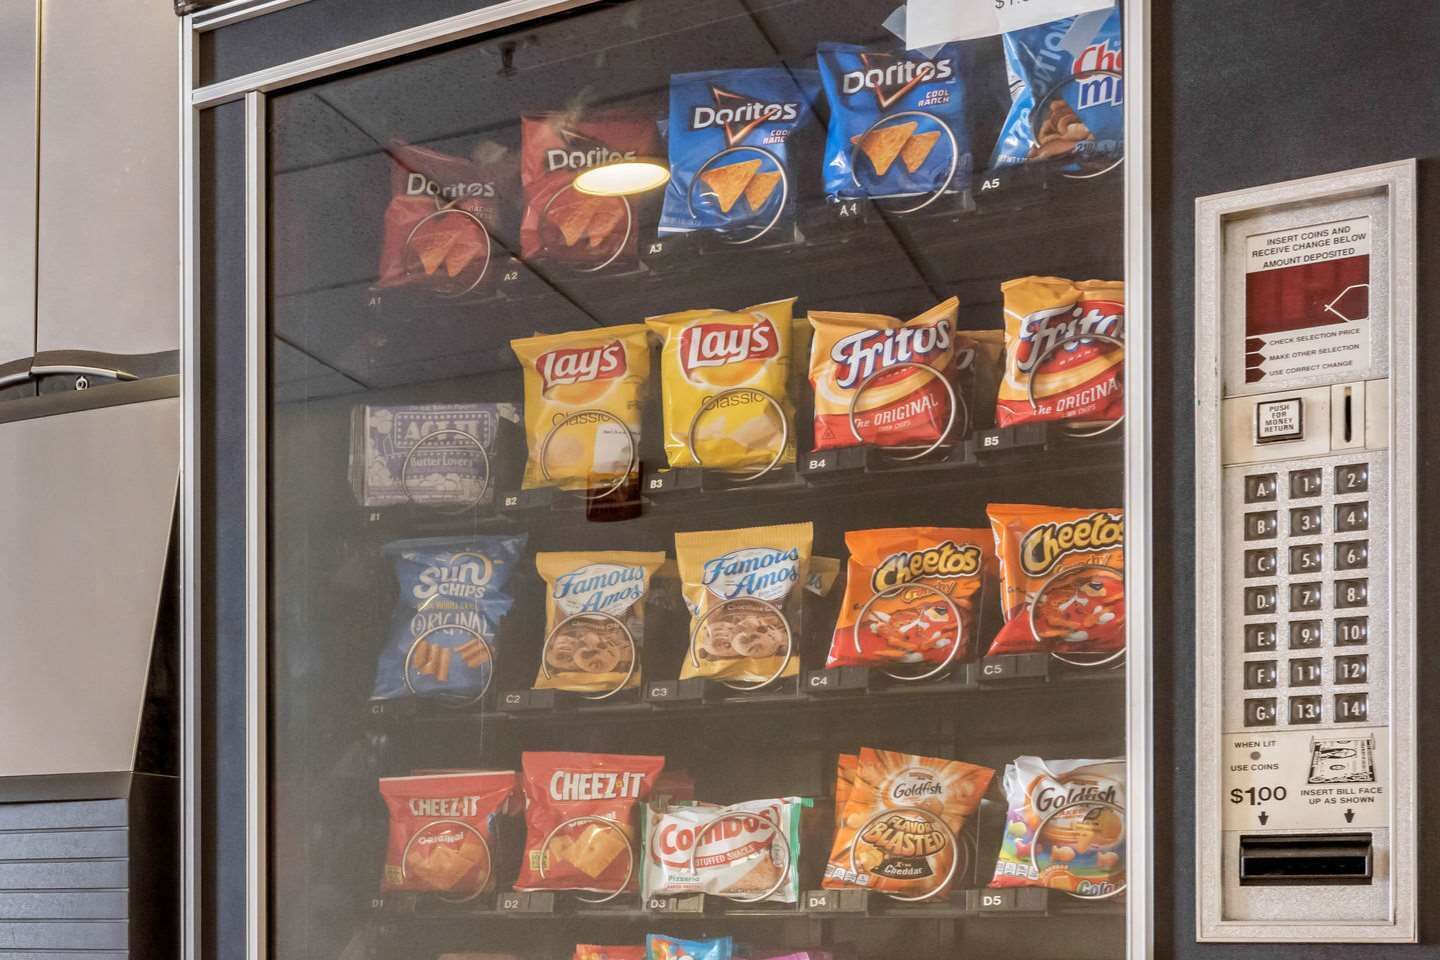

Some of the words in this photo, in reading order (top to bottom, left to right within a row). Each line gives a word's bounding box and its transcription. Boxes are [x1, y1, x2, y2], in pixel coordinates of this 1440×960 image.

[843, 58, 952, 94] Doritos
[694, 101, 799, 129] Doritos
[547, 147, 638, 171] Doritos
[407, 173, 496, 198] Doritos
[981, 178, 1000, 191] A5
[840, 203, 857, 216] A4
[1267, 234, 1298, 245] INSERT
[1301, 229, 1329, 240] COINS
[1332, 226, 1351, 235] AND
[649, 244, 664, 255] A3
[1252, 246, 1290, 258] RECEIVE
[1293, 239, 1331, 252] CHANGE
[1333, 233, 1367, 244] BELOW
[1263, 256, 1302, 269] AMOUNT
[1304, 247, 1355, 263] DEPOSITED
[504, 271, 520, 281] A2
[1017, 303, 1124, 373] Frito
[1269, 337, 1294, 346] CHECK
[1296, 331, 1337, 343] SELECTION
[1339, 328, 1361, 338] PRICE
[687, 323, 771, 371] Lay's
[831, 319, 950, 388] Fritos
[1269, 352, 1290, 361] MAKE
[1292, 349, 1316, 358] OTHER
[1318, 344, 1360, 355] SELECTION
[542, 343, 621, 386] Lay's
[1269, 368, 1284, 376] USE
[1285, 363, 1320, 375] CORRECT
[1322, 360, 1353, 370] CHANGE
[1056, 377, 1119, 411] ORIGINA
[874, 393, 939, 425] ORIGINAL
[1269, 404, 1290, 412] PUSH
[1271, 411, 1287, 419] FOR
[1264, 424, 1294, 432] RETURN
[1265, 418, 1293, 426] MONEY
[984, 436, 999, 447] B5
[810, 459, 826, 469] B4
[650, 480, 663, 489] B3
[505, 497, 517, 506] B2
[704, 548, 799, 586] Famous
[874, 542, 979, 593] Cheetos
[552, 565, 644, 600] Famous
[724, 565, 799, 599] Amos
[439, 583, 486, 598] CHIPS
[580, 587, 643, 614] Amos
[1343, 625, 1359, 640] 10
[984, 665, 1002, 675] C5
[1297, 666, 1315, 680] 11
[1343, 663, 1359, 678] 12
[811, 677, 827, 686] C4
[506, 694, 521, 704] C2
[651, 688, 667, 697] C3
[1297, 704, 1315, 719] 13
[1343, 702, 1360, 717] 14
[1234, 741, 1260, 749] WHEN
[1251, 763, 1279, 771] COINS
[893, 781, 942, 799] Goldfish
[1230, 786, 1287, 806] $1.00
[1300, 788, 1333, 796] INSERT
[1036, 785, 1116, 812] Goldfish
[1340, 796, 1374, 804] SHOWN
[888, 816, 933, 834] FLAVOR
[862, 822, 945, 857] BLASTED
[884, 864, 923, 876] Cheddar
[504, 899, 519, 909] D2
[650, 899, 666, 908] D3
[810, 897, 827, 906] D4
[983, 896, 1002, 906] D5
